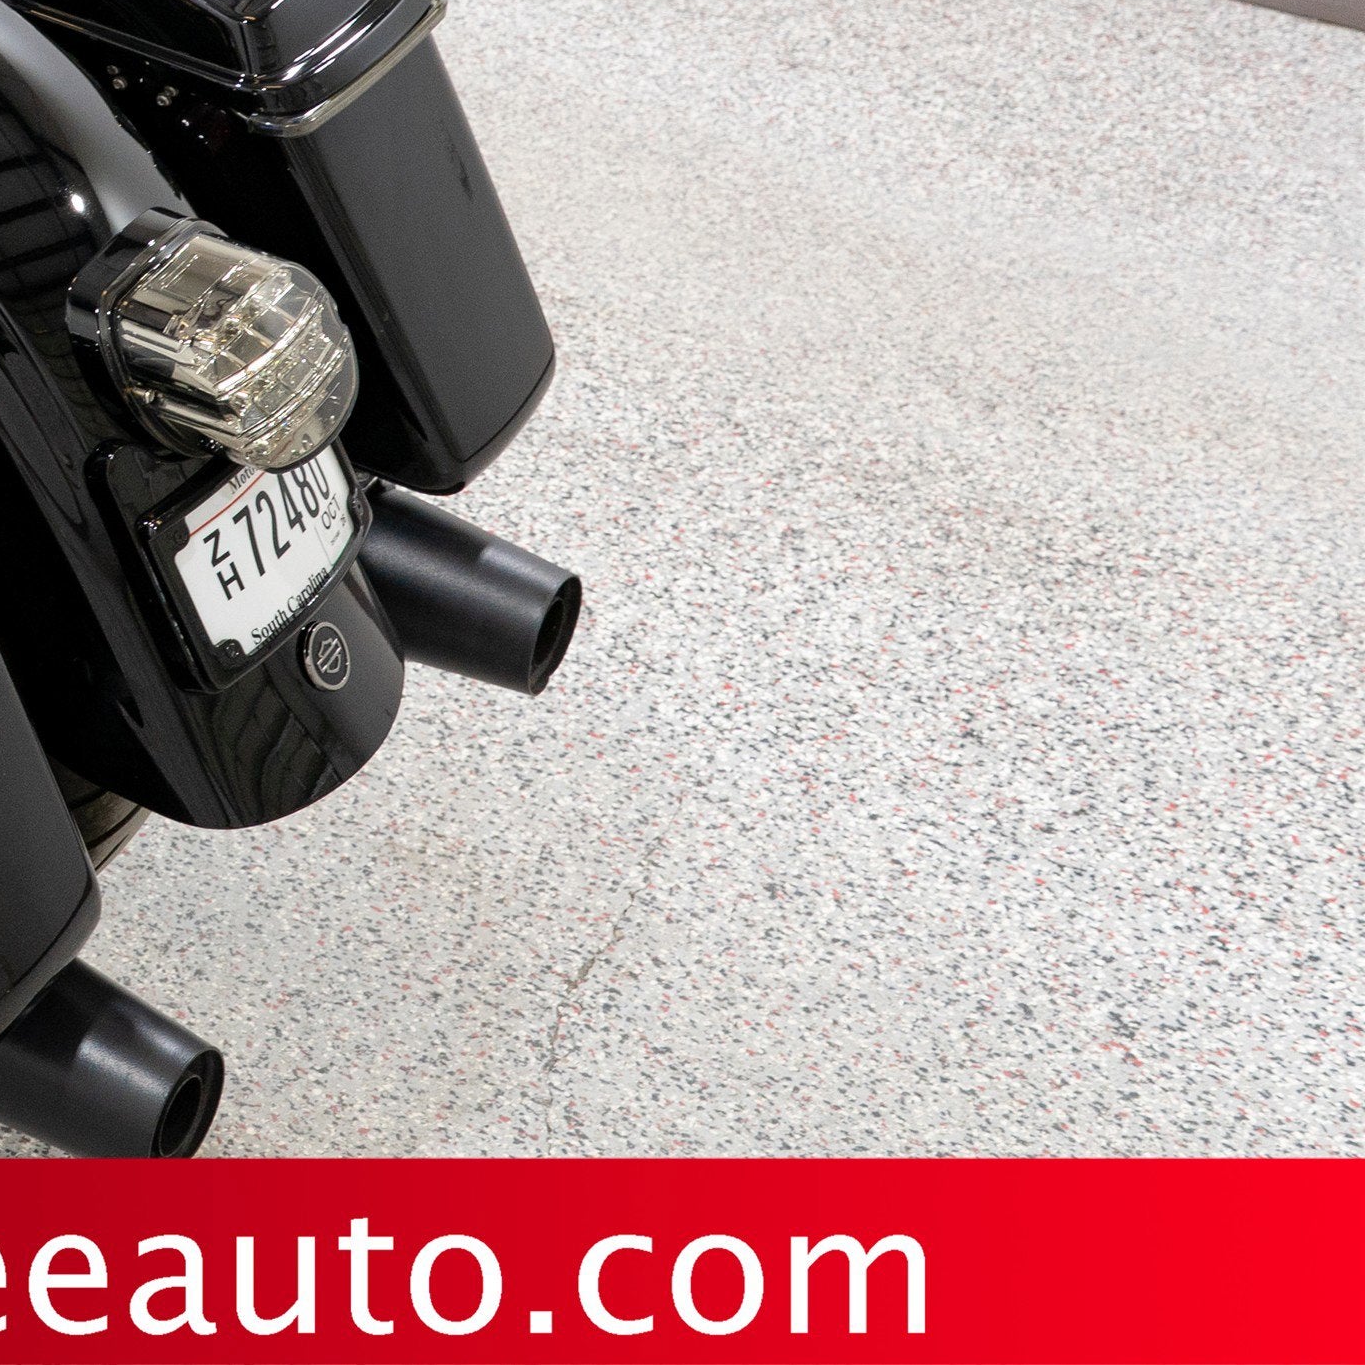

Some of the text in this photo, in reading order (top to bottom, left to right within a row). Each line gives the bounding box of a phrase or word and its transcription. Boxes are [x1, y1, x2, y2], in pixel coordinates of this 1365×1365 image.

[232, 458, 331, 578] 72480
[322, 493, 341, 530] OCT
[250, 566, 330, 646] South Carolina
